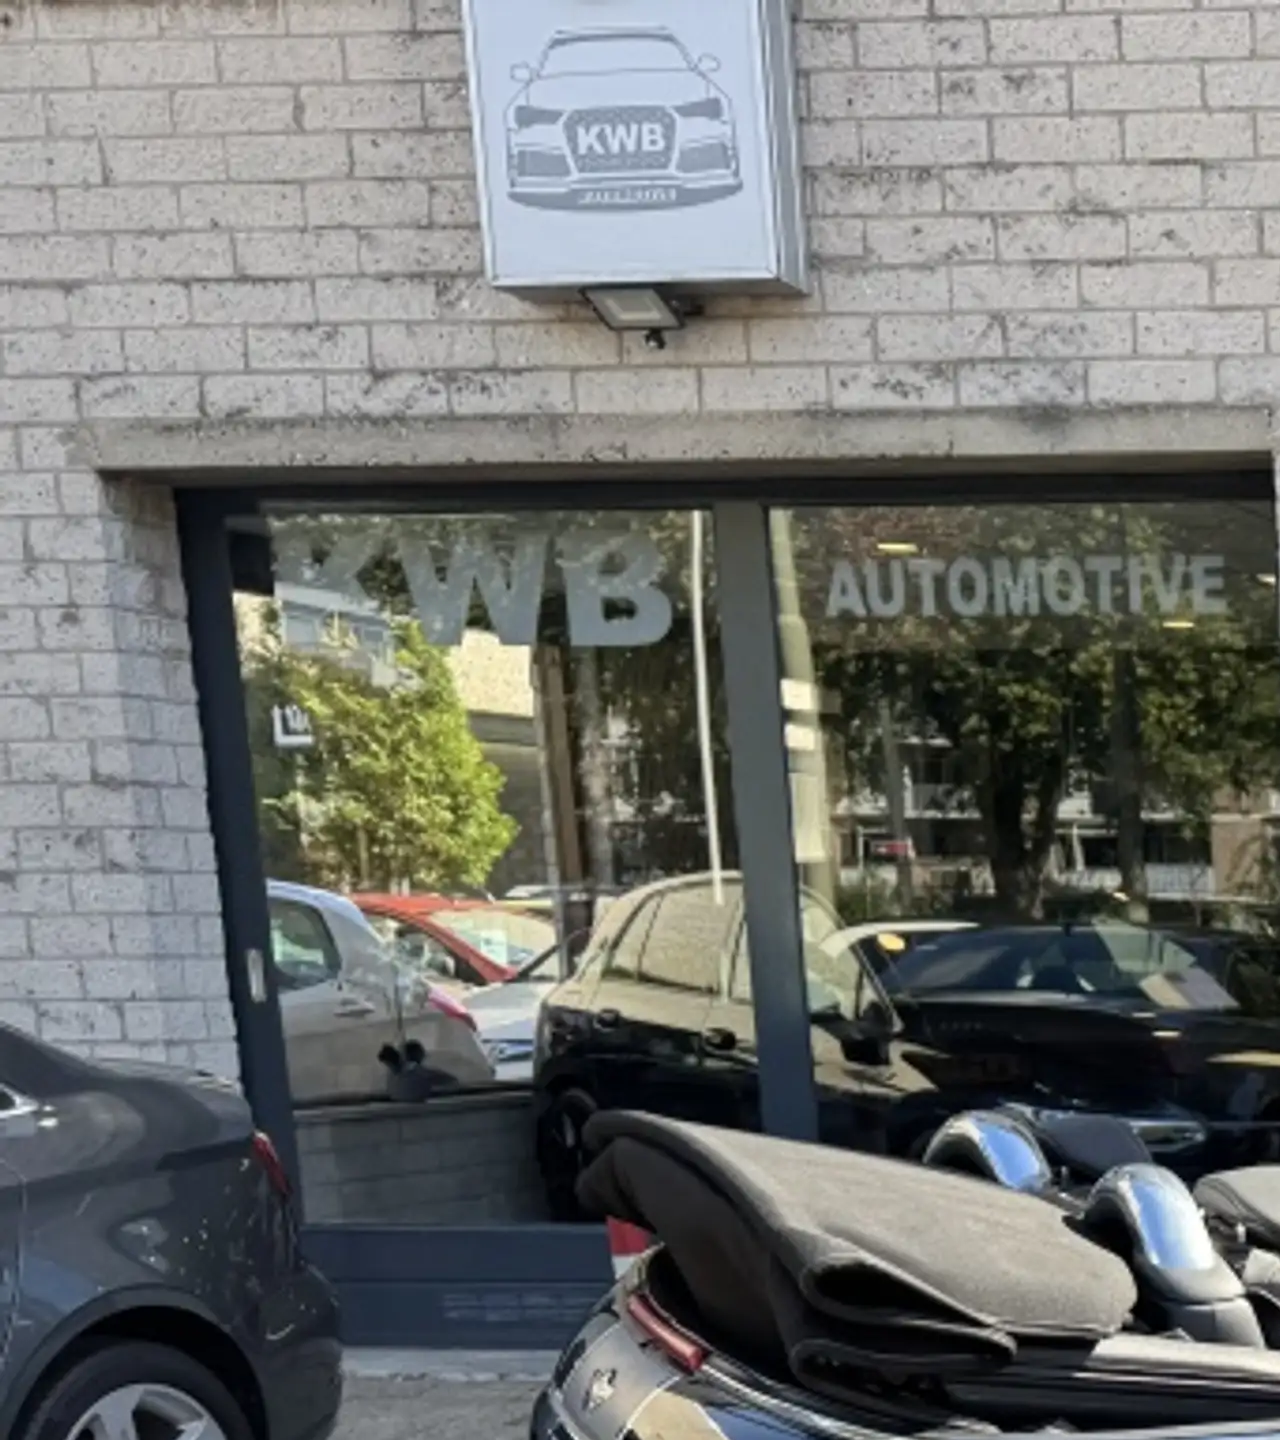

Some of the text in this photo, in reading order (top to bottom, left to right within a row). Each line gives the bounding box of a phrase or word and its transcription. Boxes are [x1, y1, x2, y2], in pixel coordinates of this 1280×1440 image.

[577, 122, 666, 155] KWB
[274, 526, 674, 646] KWB
[826, 553, 1228, 618] AUTOMOTIVE
